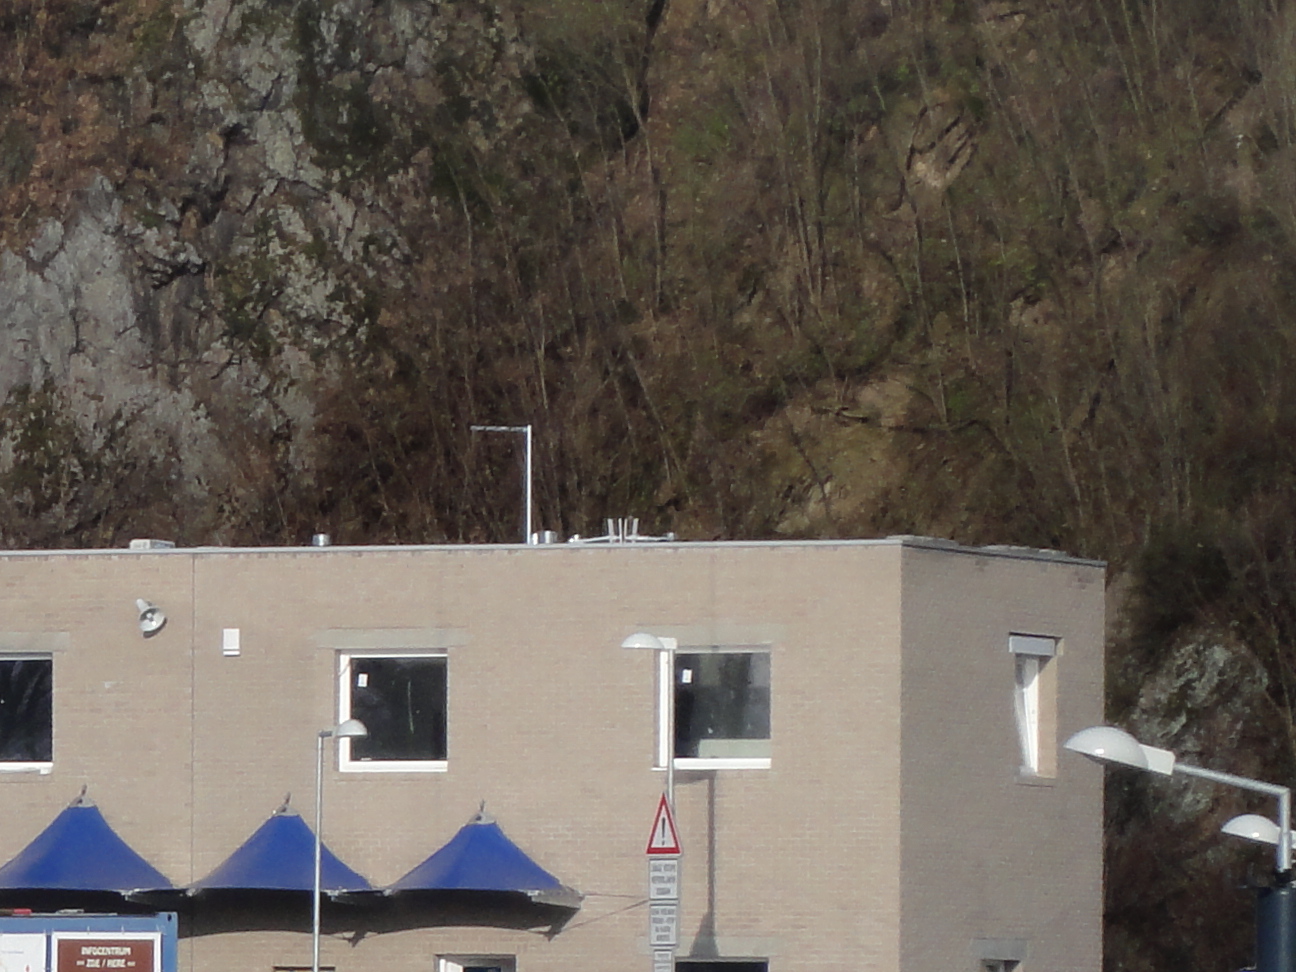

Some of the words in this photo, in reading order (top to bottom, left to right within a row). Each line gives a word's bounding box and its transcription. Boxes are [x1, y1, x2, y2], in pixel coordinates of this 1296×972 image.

[81, 946, 131, 955] INFOCENTRUM
[86, 959, 100, 968] ZDE
[107, 959, 126, 968] HERE
